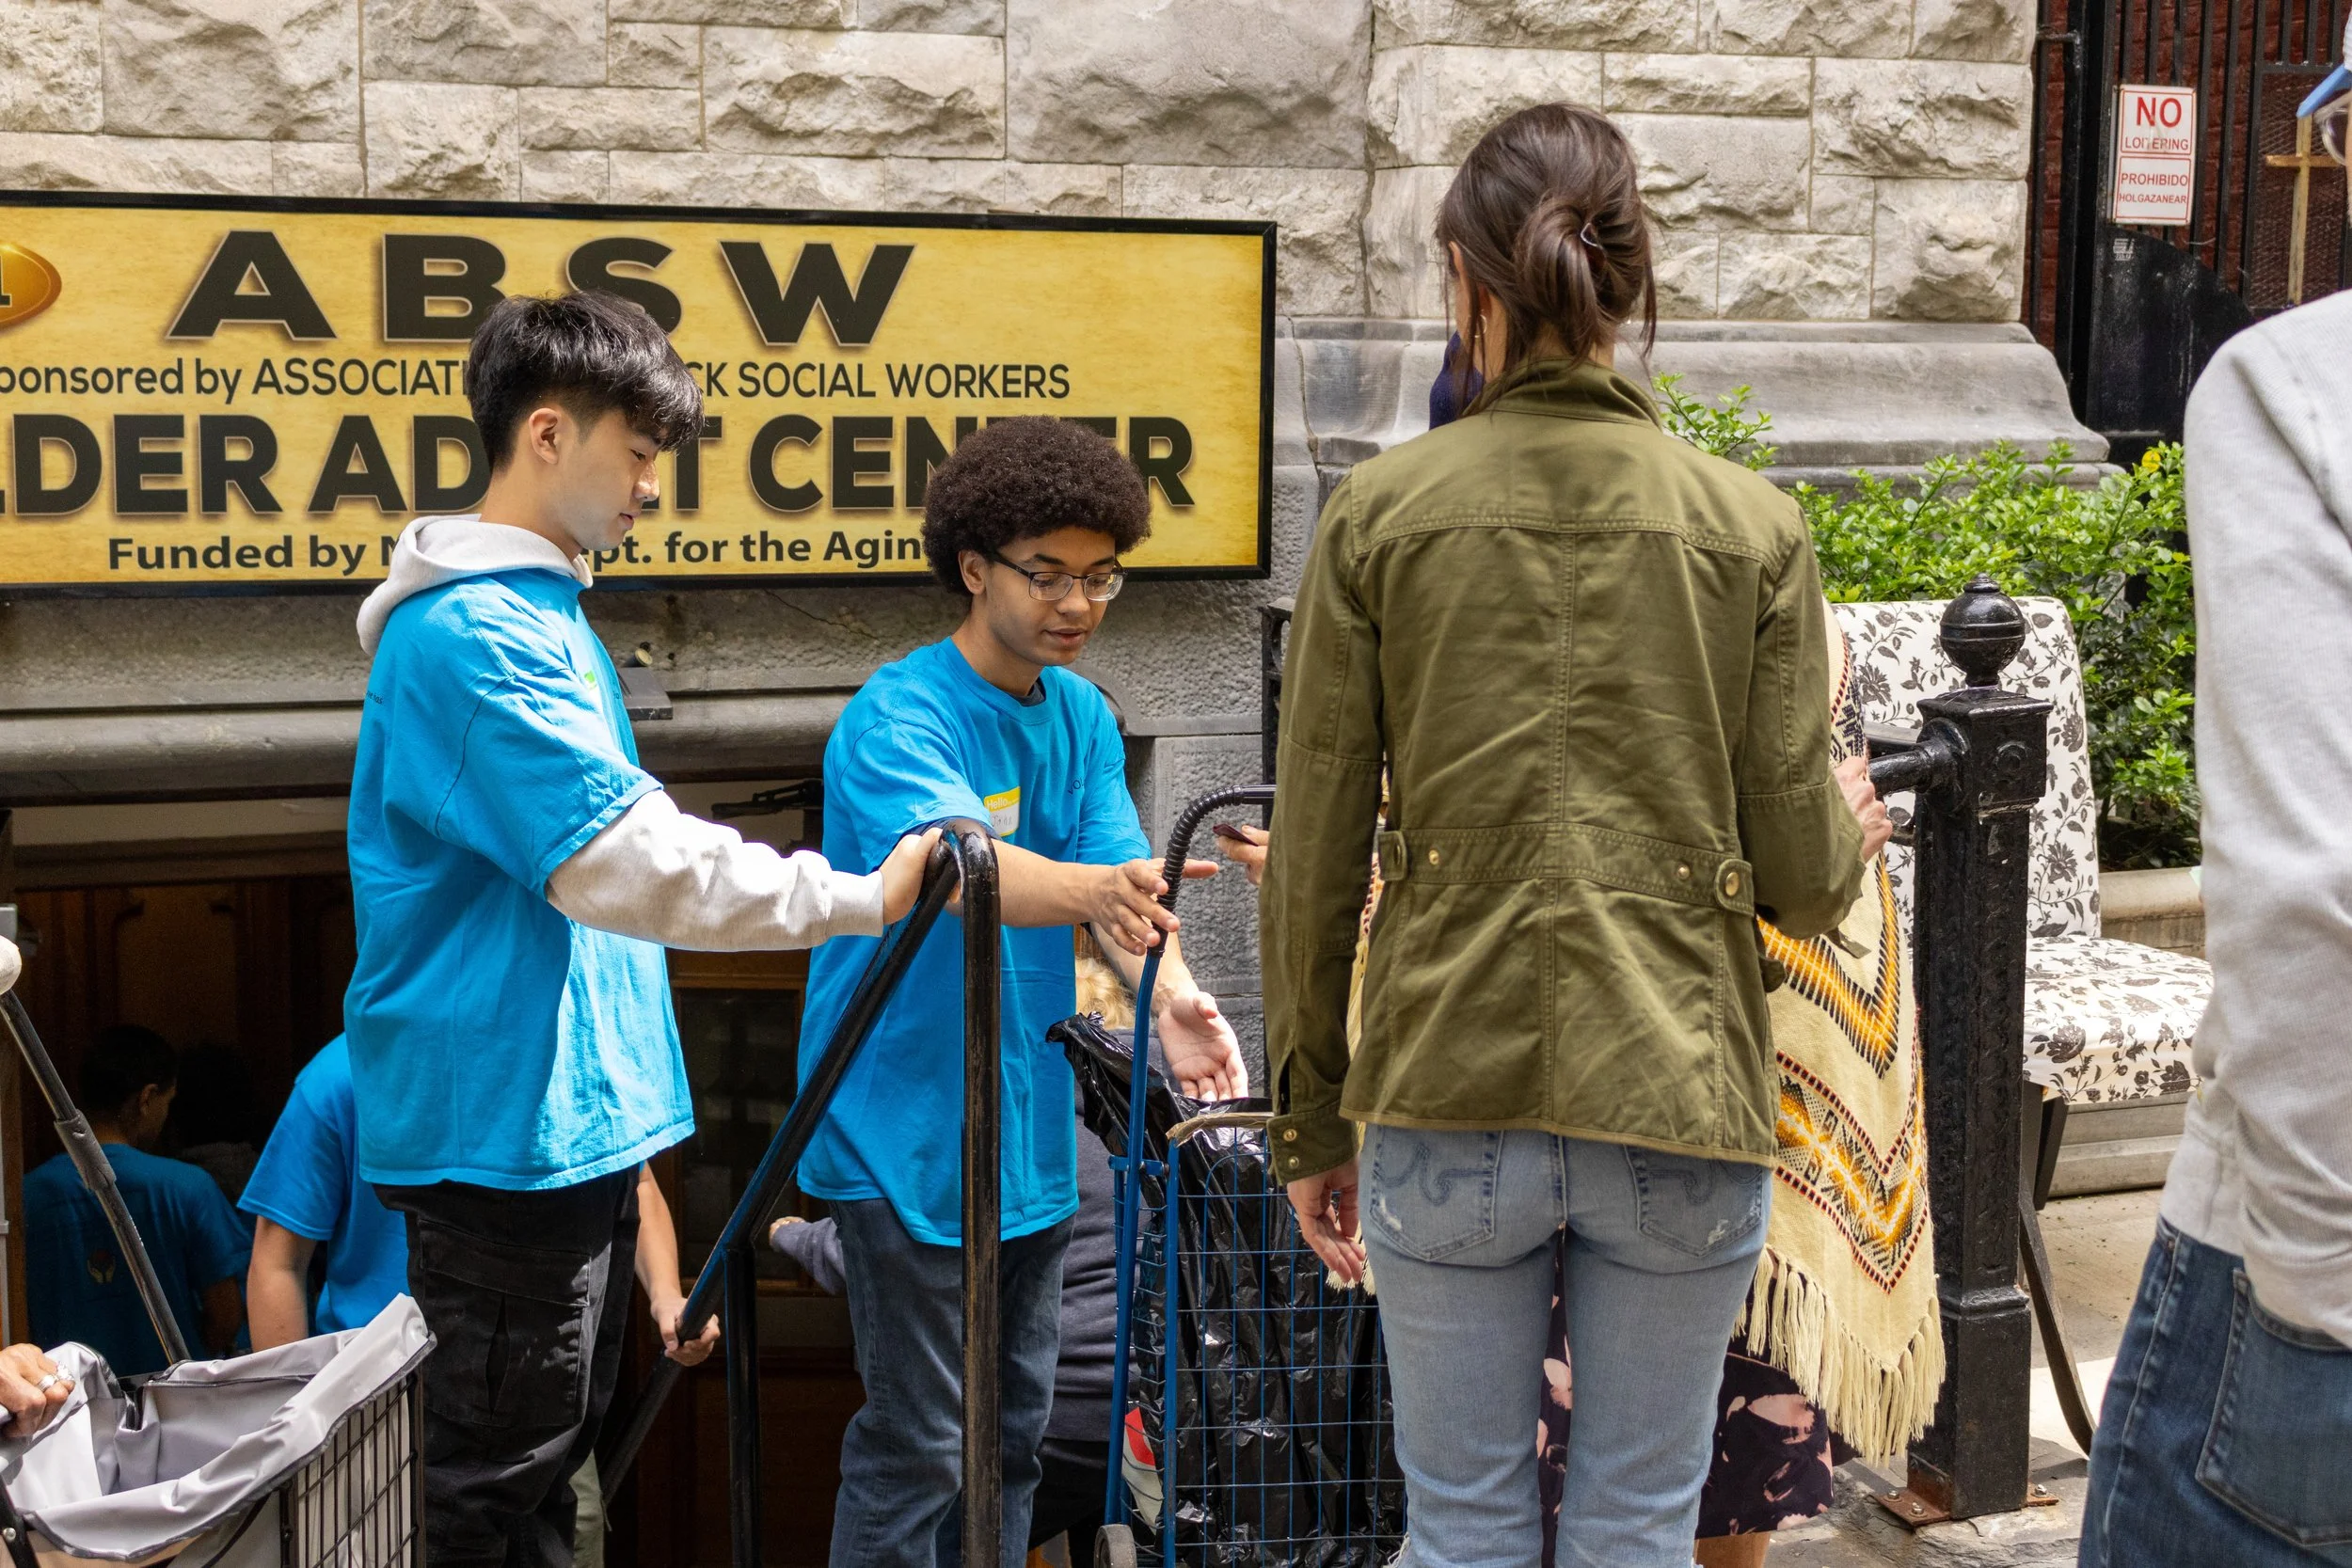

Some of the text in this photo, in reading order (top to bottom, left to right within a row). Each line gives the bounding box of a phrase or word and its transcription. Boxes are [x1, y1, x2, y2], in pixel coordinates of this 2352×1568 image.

[2136, 97, 2182, 127] NO
[2118, 193, 2186, 204] HOLGAZANEAR
[2121, 172, 2188, 187] PROHIBIDO
[195, 357, 243, 405] by
[738, 361, 877, 399] SOCIAL
[885, 363, 1071, 399] WORKERS
[0, 413, 283, 515] DER
[307, 414, 723, 513] ADT
[108, 535, 293, 569] Funded
[309, 534, 367, 576] by
[582, 534, 652, 572] pt.
[664, 531, 728, 563] for
[739, 531, 811, 562] the
[823, 530, 921, 568] Agin
